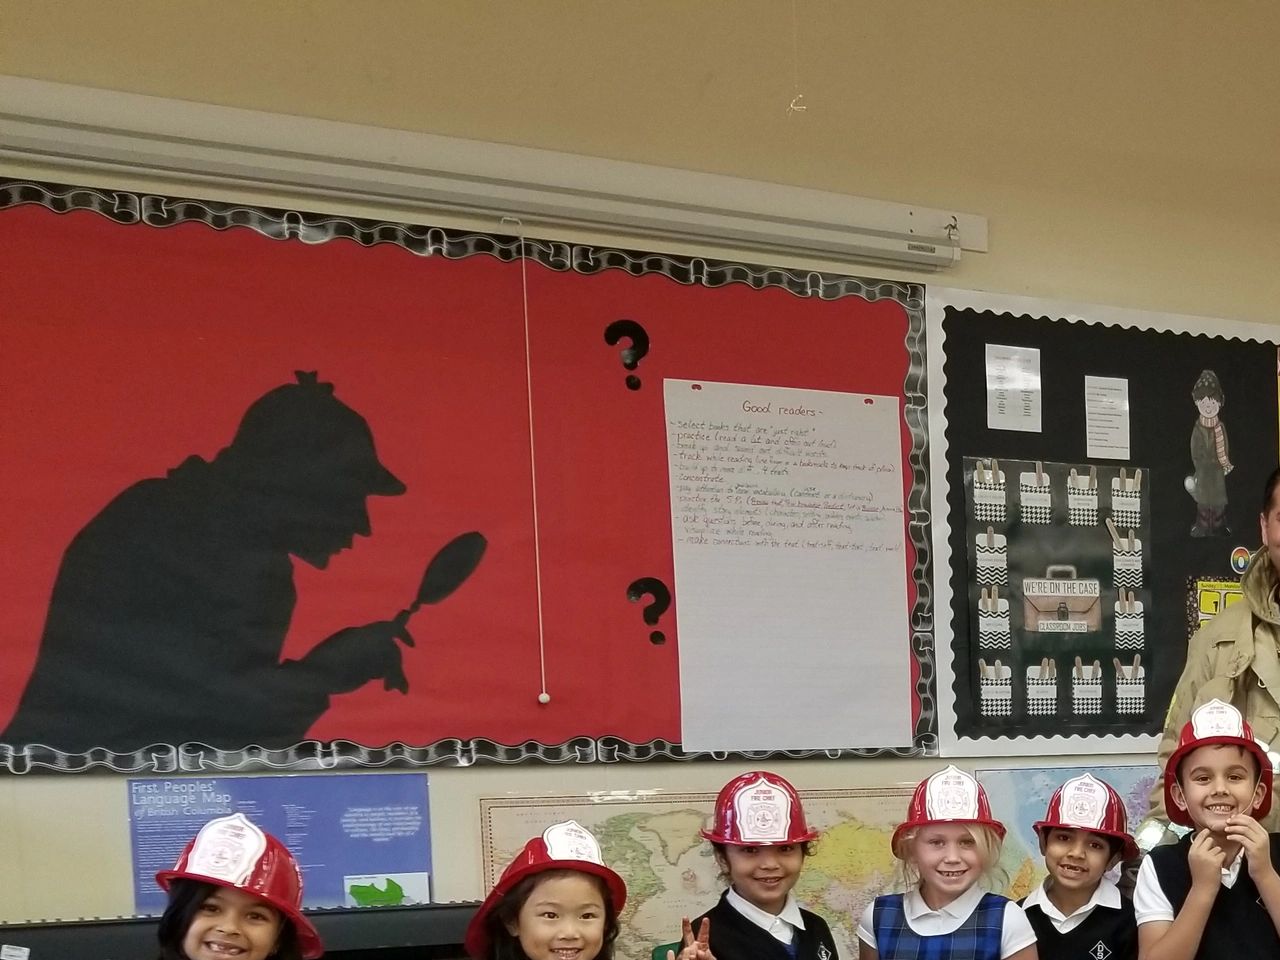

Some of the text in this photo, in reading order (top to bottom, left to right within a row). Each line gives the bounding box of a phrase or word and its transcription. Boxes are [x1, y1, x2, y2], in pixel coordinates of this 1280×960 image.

[742, 400, 771, 414] Good
[709, 422, 729, 431] books
[733, 424, 751, 433] that
[765, 437, 781, 446] and
[1024, 581, 1099, 595] WE'RE ON THE CASE
[1039, 622, 1087, 632] CLASSROOM JOBS
[132, 782, 160, 794] First
[132, 791, 232, 807] Language Map
[147, 807, 179, 817] British
[183, 806, 233, 816] Columbia
